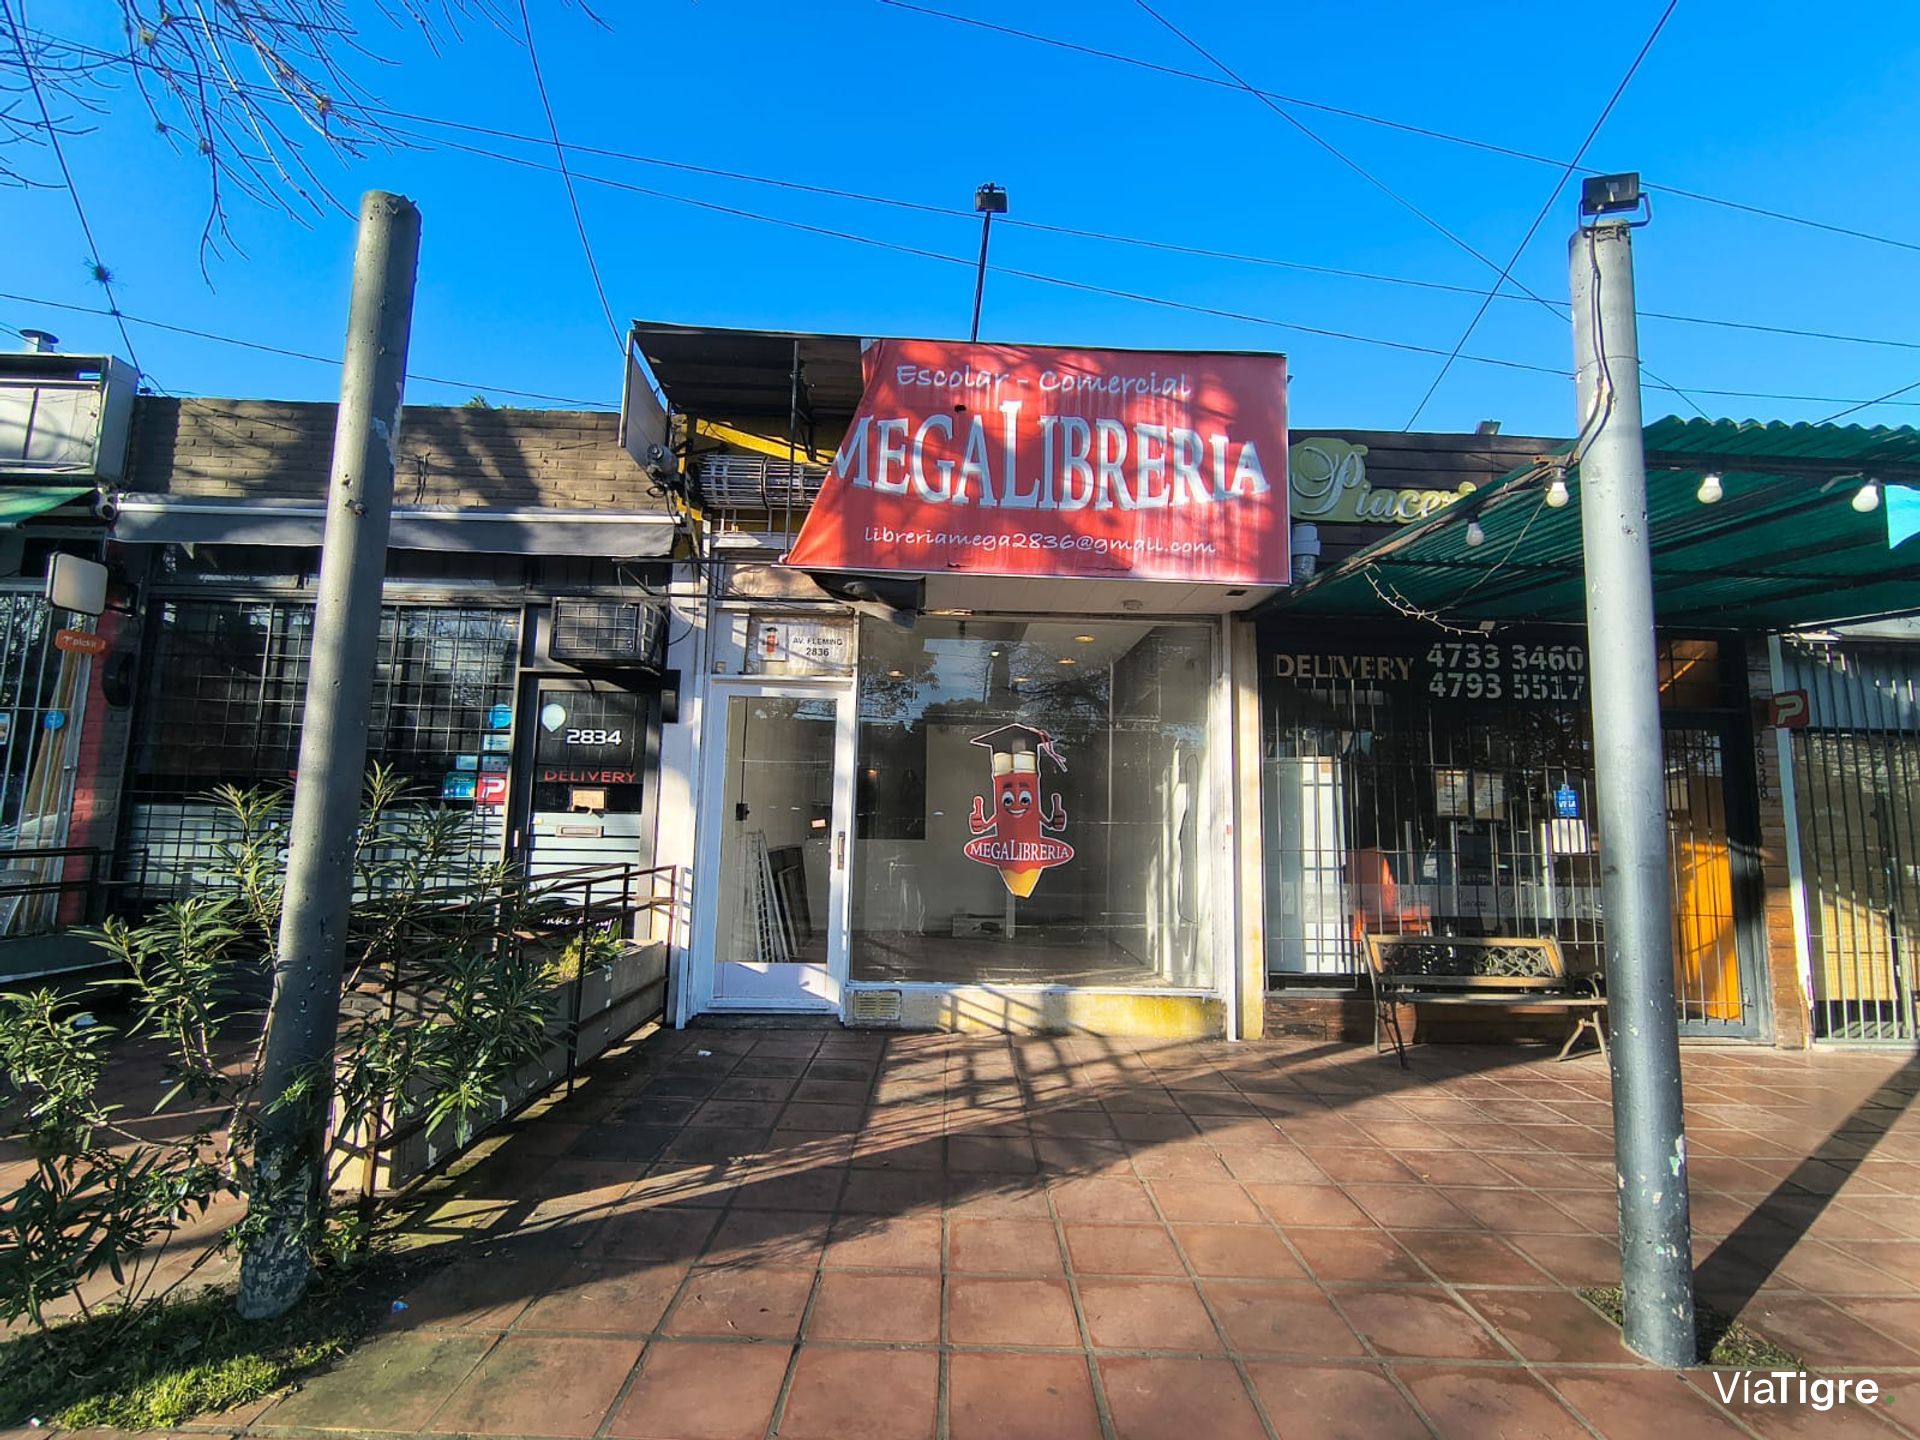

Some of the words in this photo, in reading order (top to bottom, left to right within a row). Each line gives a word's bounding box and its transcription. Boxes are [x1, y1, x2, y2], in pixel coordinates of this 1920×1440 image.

[896, 365, 1010, 387] Escolar
[1039, 370, 1192, 396] Comercial
[833, 400, 1272, 511] MEGALIBRERIA
[863, 526, 1217, 555] libreriamega2836@gmail.com
[806, 647, 830, 657] 2836
[807, 638, 843, 647] FLEMING
[1275, 653, 1414, 681] DELIVERY
[1426, 642, 1501, 670] 4733
[1511, 644, 1585, 672] 3460
[1428, 671, 1503, 699] 4793
[1513, 673, 1586, 701] 5517
[566, 728, 622, 746] 2834
[544, 769, 637, 784] DELIVERY
[969, 838, 1070, 862] MEGALIBRERIA
